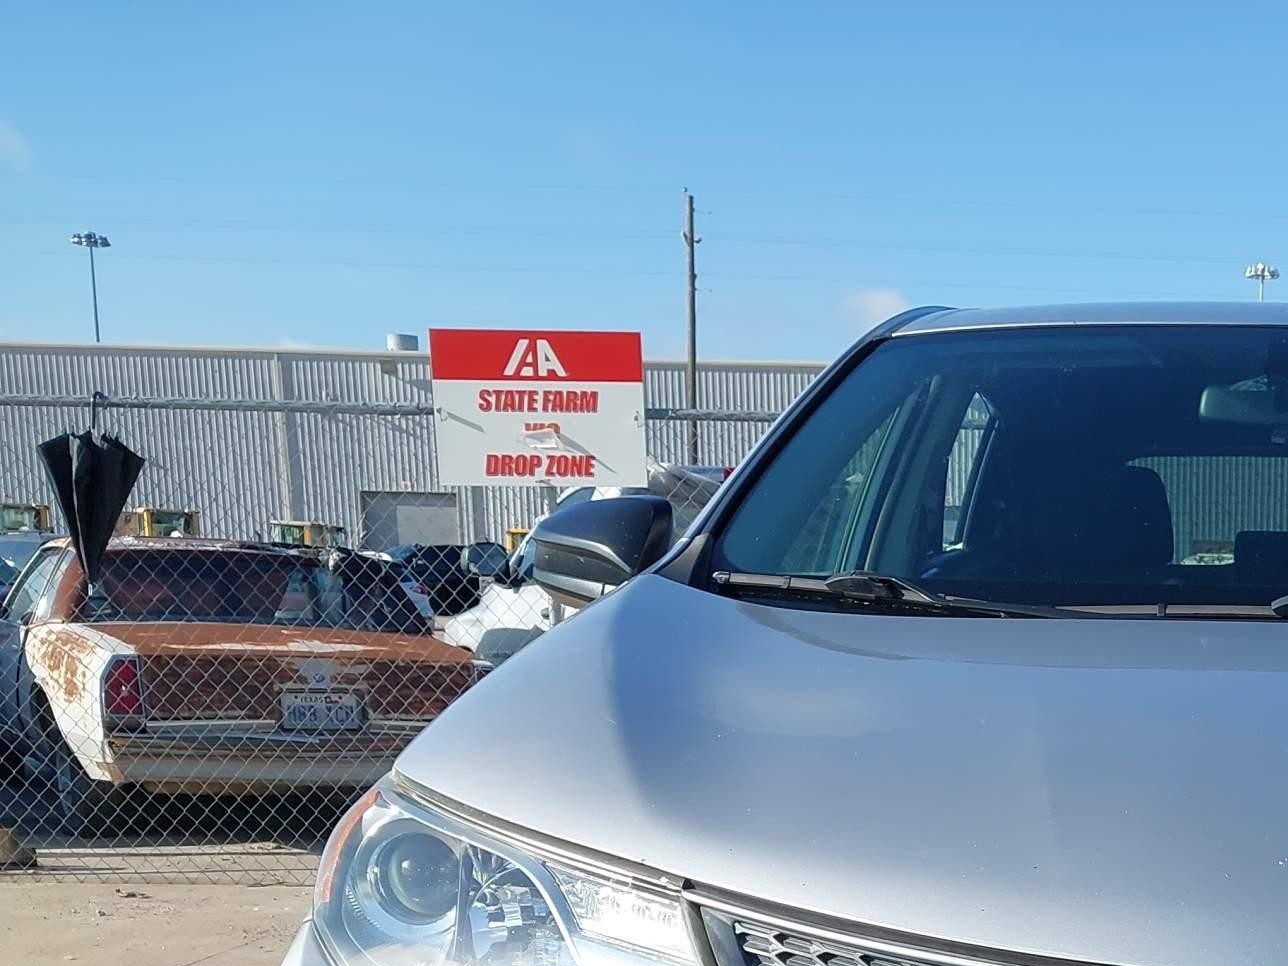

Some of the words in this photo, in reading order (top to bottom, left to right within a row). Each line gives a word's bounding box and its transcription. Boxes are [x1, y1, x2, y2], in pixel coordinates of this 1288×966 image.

[478, 389, 538, 413] STATE
[542, 390, 599, 414] FARM
[485, 454, 542, 477] DROP
[544, 454, 597, 478] ZONE
